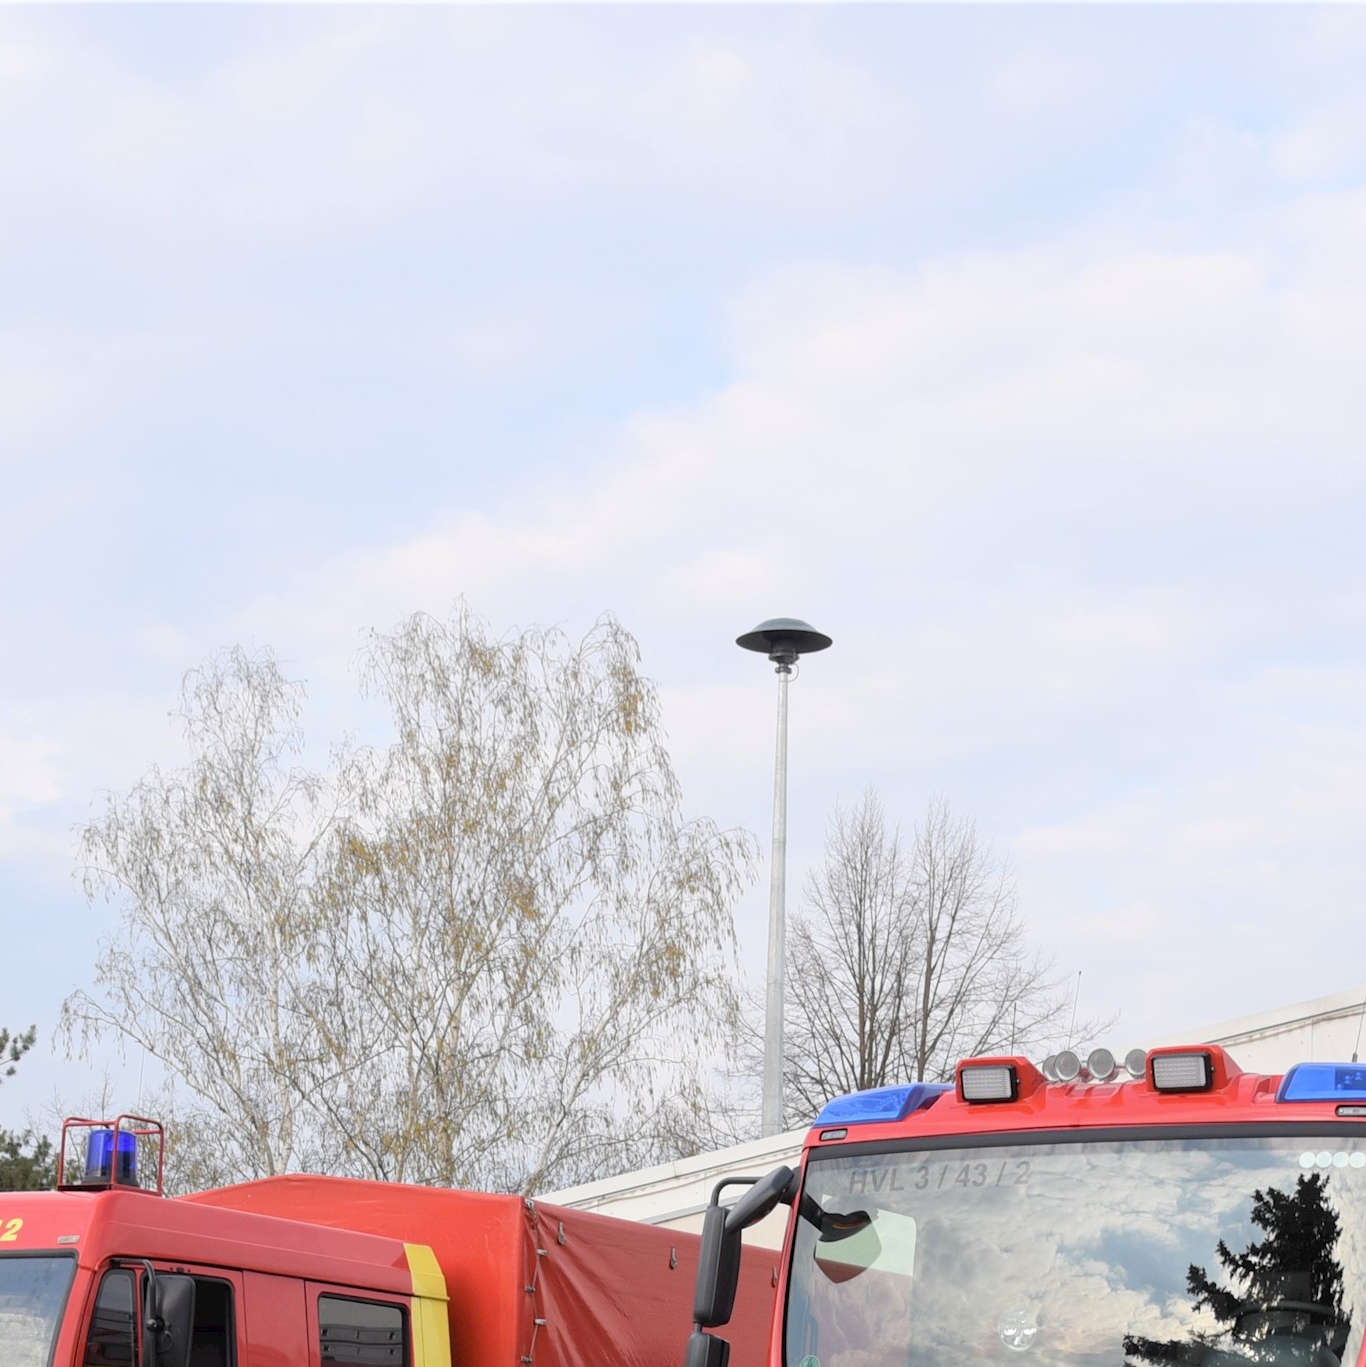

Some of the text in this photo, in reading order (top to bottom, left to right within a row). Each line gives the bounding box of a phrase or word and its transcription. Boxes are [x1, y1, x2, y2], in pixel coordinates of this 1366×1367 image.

[848, 1167, 905, 1194] HVL
[914, 1166, 930, 1190] 3
[955, 1163, 988, 1188] 43
[1014, 1160, 1032, 1185] 2
